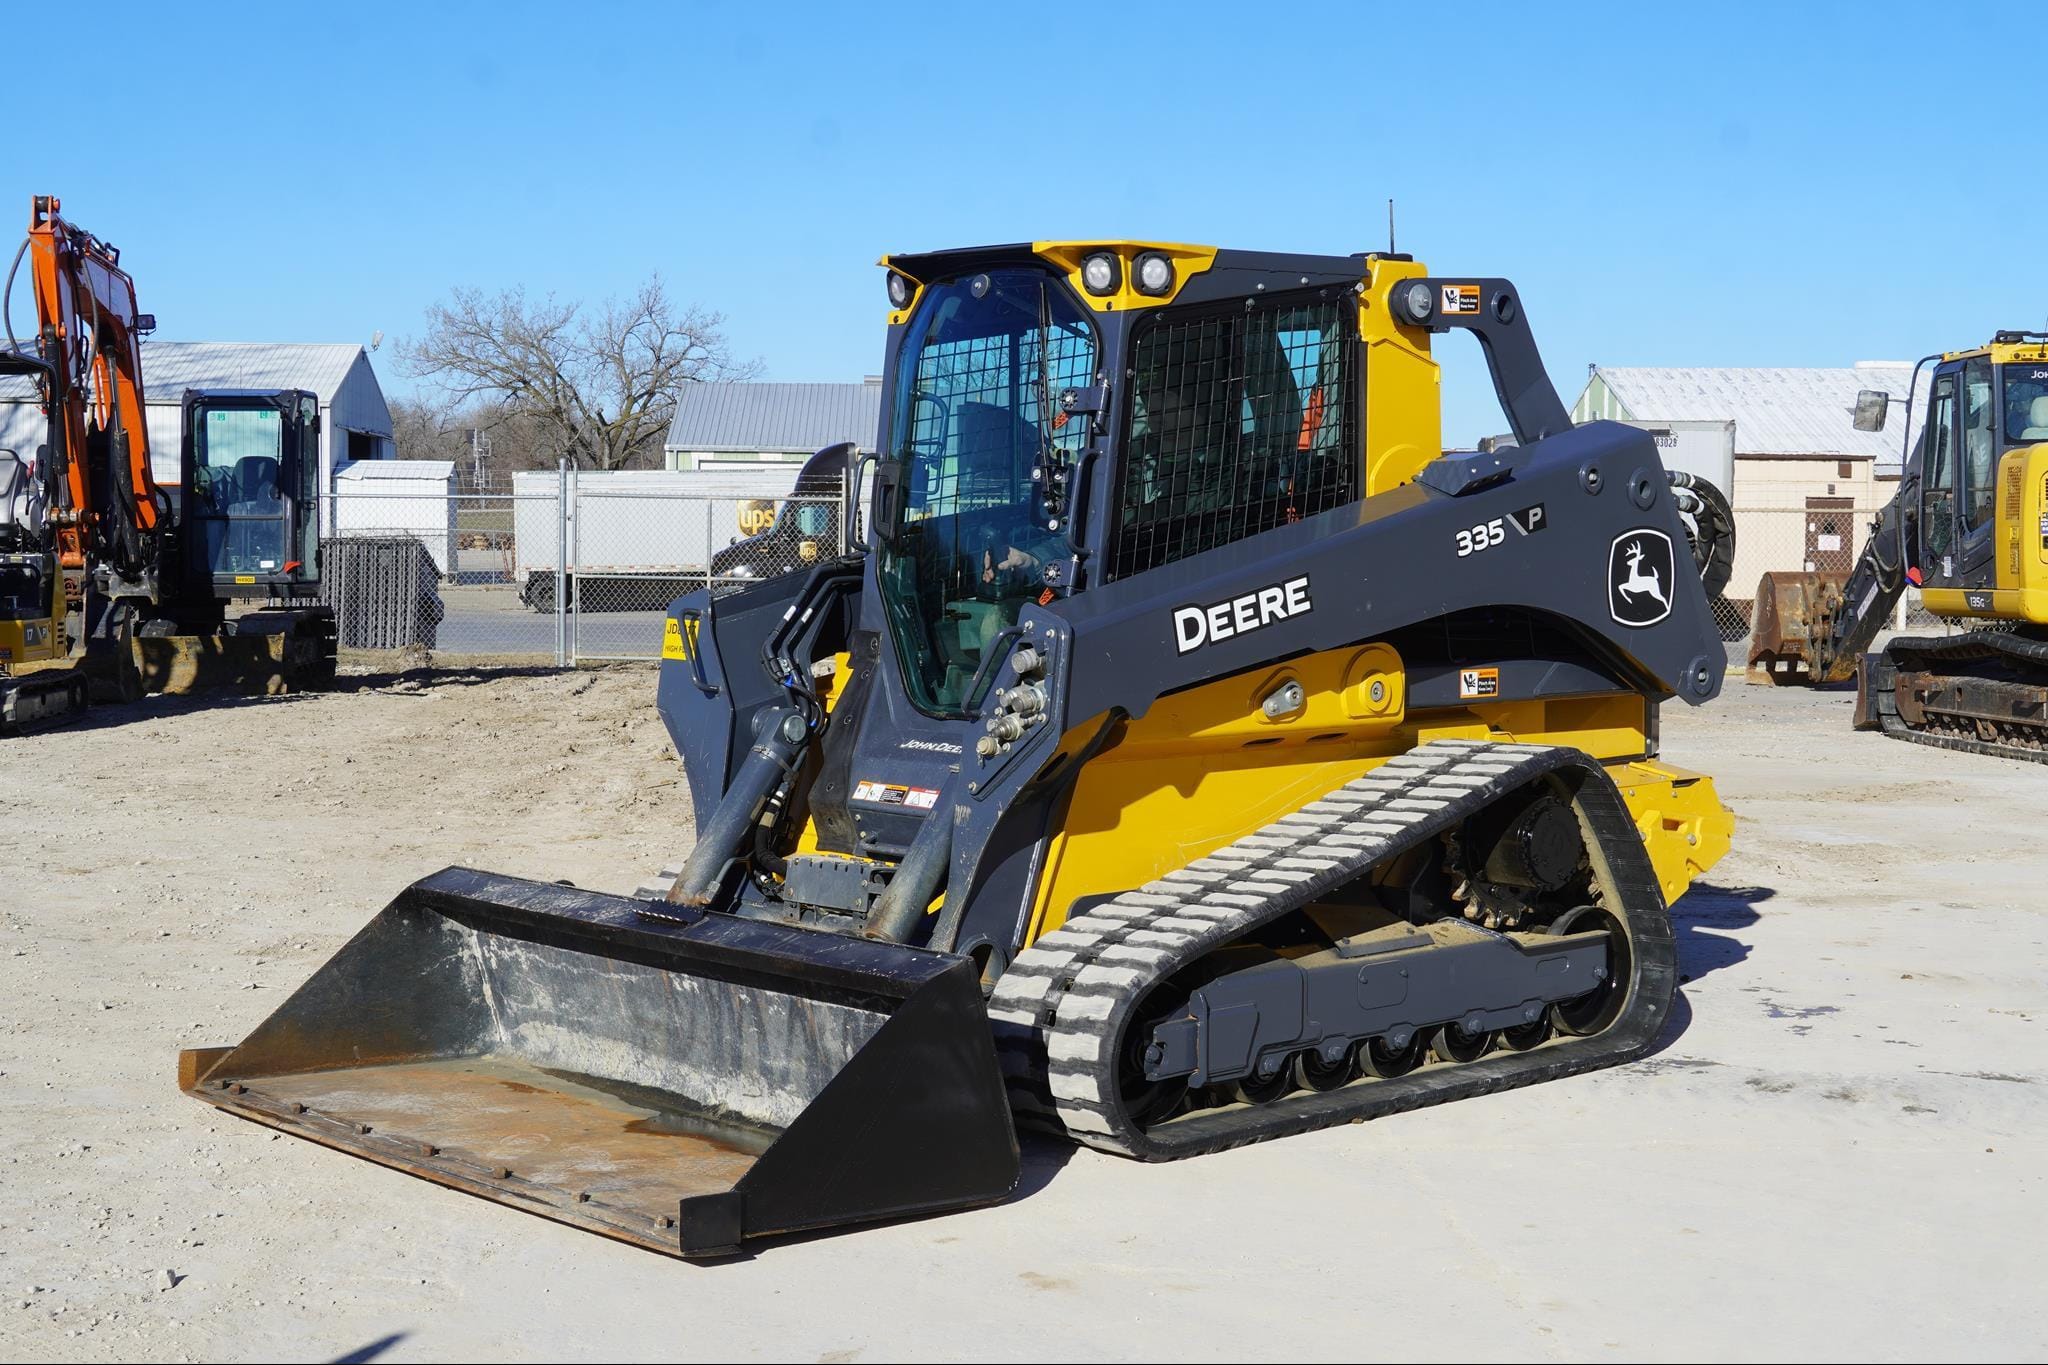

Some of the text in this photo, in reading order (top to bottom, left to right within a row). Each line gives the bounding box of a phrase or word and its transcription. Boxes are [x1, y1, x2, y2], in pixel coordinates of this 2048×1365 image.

[740, 509, 774, 535] ups
[1455, 518, 1505, 557] 335
[801, 547, 816, 559] ups
[1970, 596, 1985, 608] 135G
[1174, 577, 1311, 653] DEERE
[27, 629, 33, 640] 17
[900, 740, 938, 751] JOHN
